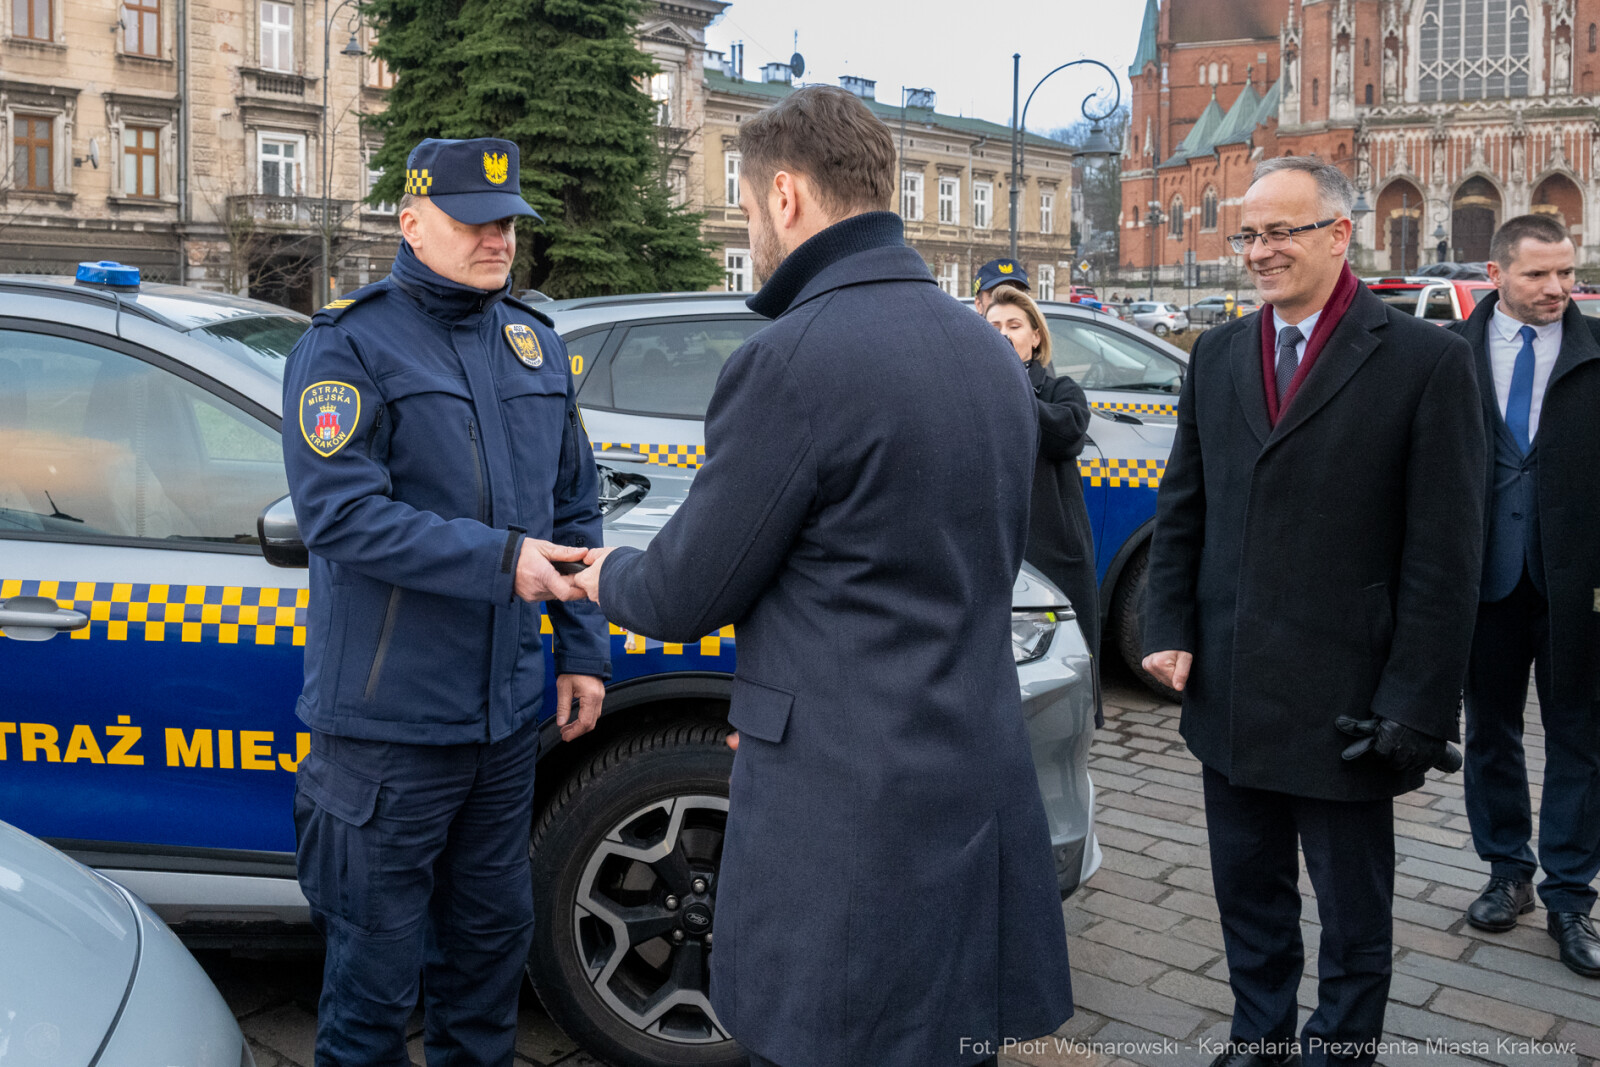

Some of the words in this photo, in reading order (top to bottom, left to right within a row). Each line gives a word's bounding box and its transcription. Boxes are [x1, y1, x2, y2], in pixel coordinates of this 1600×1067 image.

[567, 354, 584, 376] 0
[312, 386, 346, 396] STRAŻ
[308, 394, 351, 406] MIEJSKA
[165, 727, 311, 773] MIEJ
